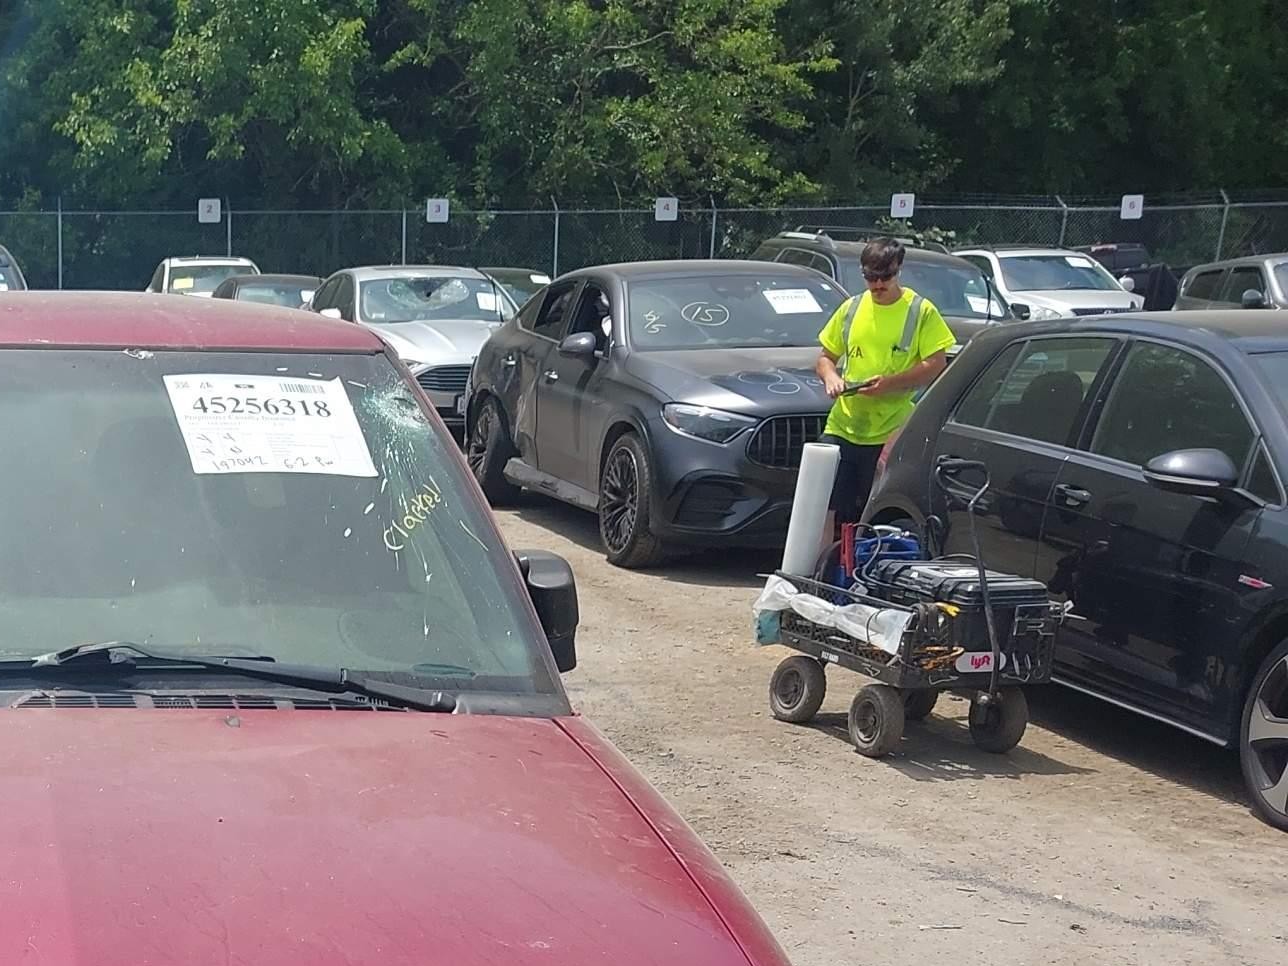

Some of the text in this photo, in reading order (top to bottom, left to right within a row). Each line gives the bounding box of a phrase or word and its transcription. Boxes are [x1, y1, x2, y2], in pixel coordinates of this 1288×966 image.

[691, 306, 724, 322] 15
[192, 396, 332, 418] 45256318
[971, 655, 990, 669] lyft
